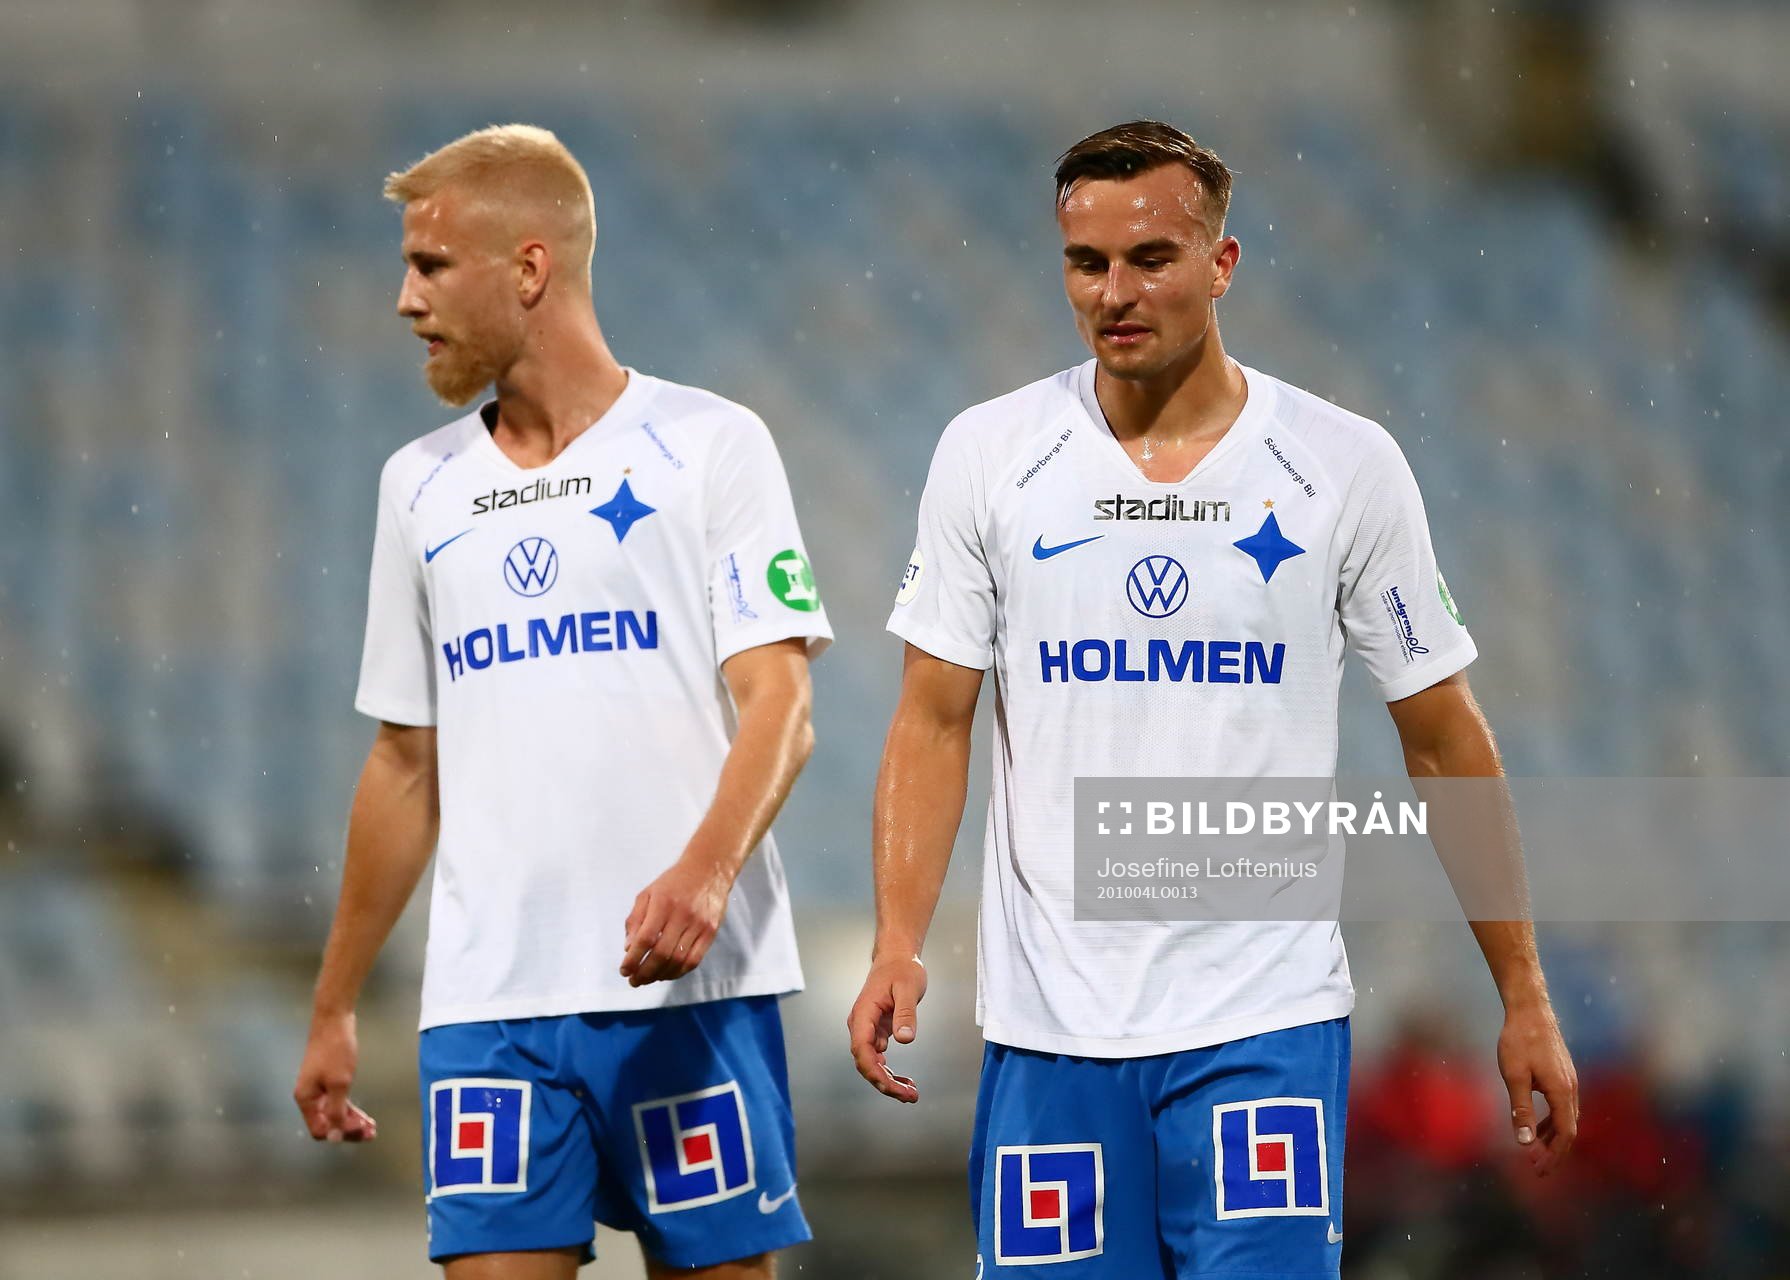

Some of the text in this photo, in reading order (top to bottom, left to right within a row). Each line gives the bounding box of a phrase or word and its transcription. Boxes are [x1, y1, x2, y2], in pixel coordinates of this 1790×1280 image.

[1016, 429, 1073, 489] Söderbergs Bil
[1264, 437, 1316, 498] Söderbergs Bil
[472, 476, 591, 515] stadium
[1093, 494, 1230, 522] stadium
[1390, 586, 1414, 637] lundgrens
[442, 610, 658, 682] HOLMEN
[1039, 639, 1286, 684] HOLMEN
